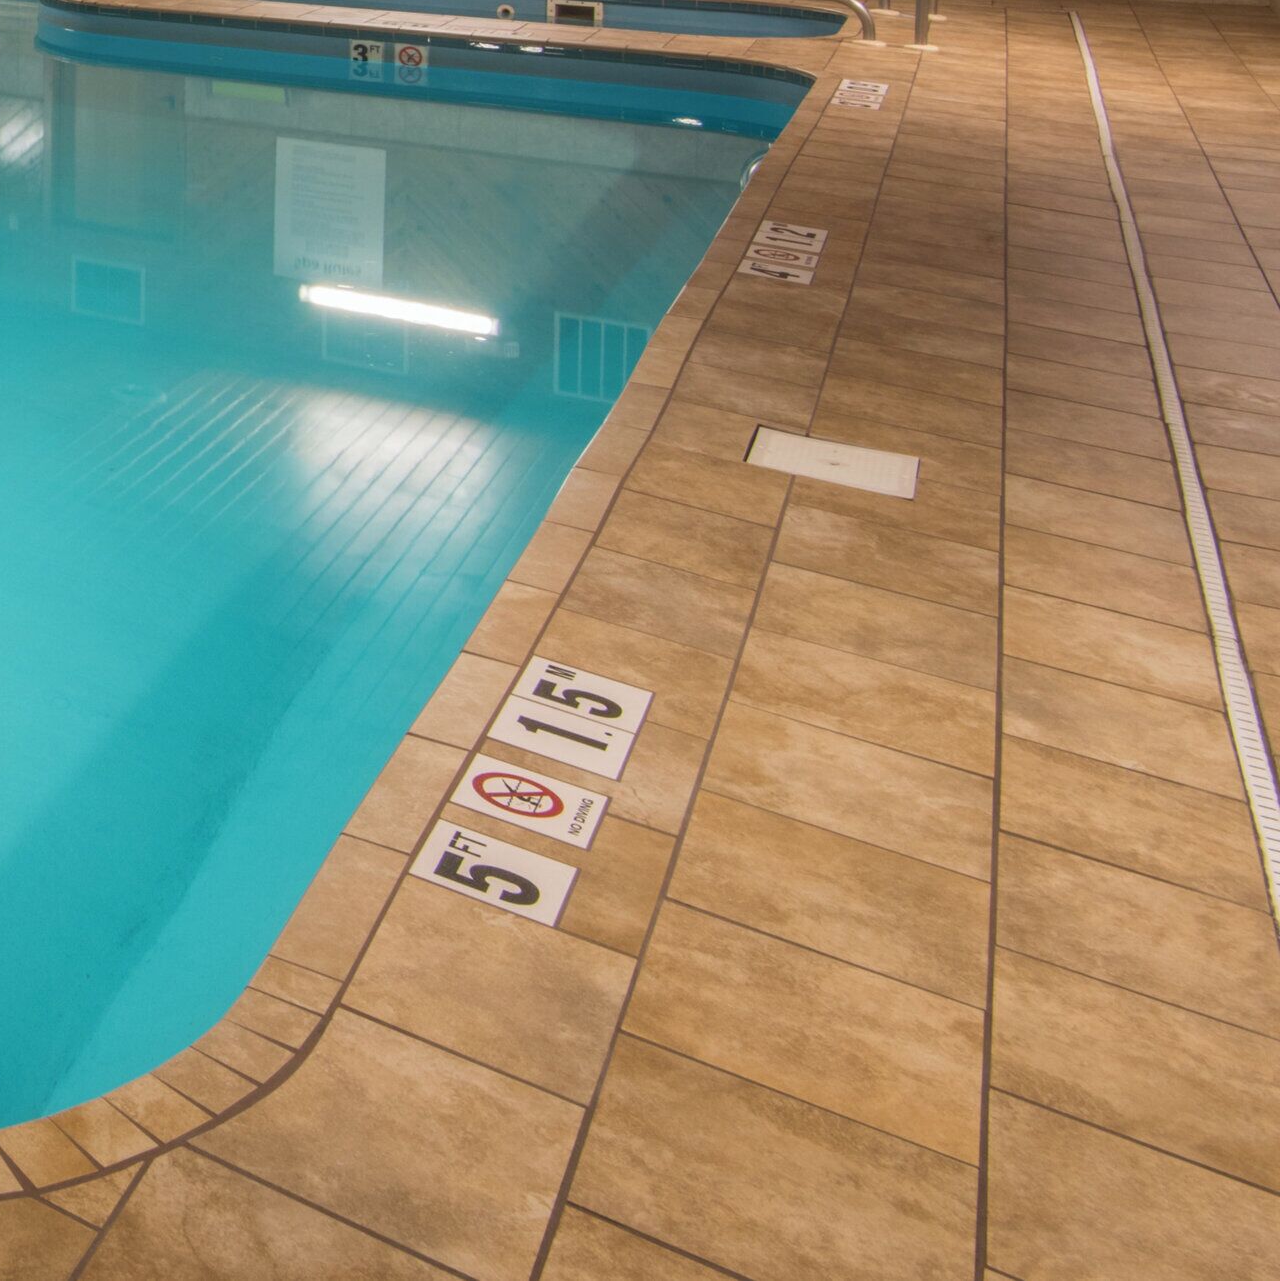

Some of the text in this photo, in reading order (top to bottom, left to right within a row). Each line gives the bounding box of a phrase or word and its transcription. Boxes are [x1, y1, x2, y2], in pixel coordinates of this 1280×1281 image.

[352, 44, 381, 62] 3 FT
[517, 664, 623, 751] 1.5 M
[568, 798, 594, 837] NO DIVING
[433, 830, 540, 906] 5 FT
